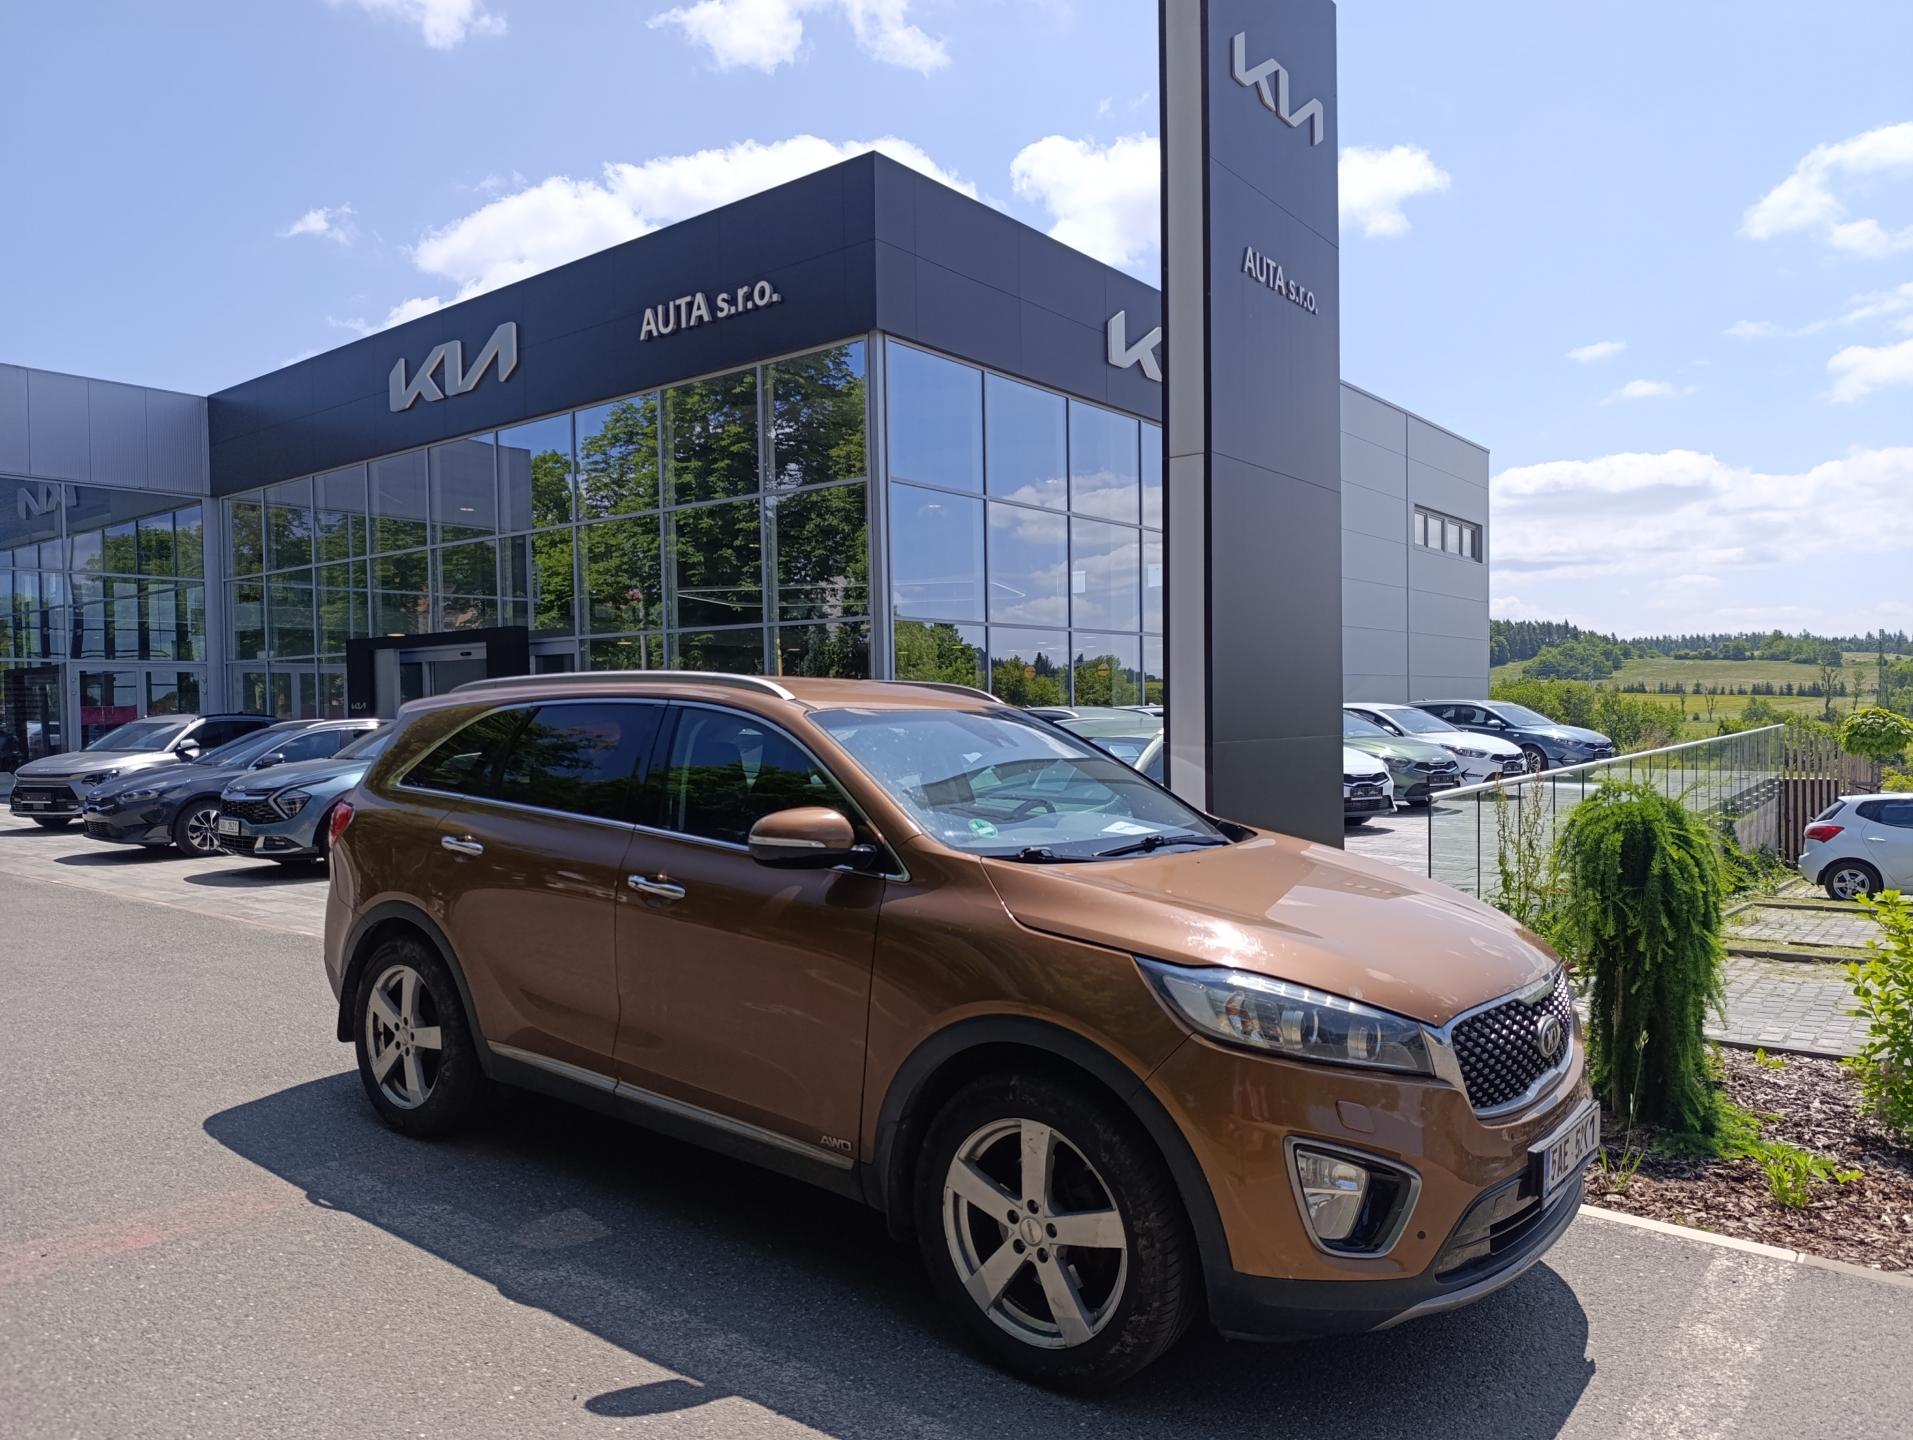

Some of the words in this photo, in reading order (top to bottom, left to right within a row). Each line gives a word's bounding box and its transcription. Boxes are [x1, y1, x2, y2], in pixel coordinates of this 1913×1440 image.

[1231, 31, 1324, 146] KIA
[640, 291, 713, 341] AUTA
[716, 280, 782, 318] s.r.o.
[1242, 246, 1286, 295] AUTA
[1287, 280, 1319, 315] s.r.o.
[389, 321, 518, 412] KIA
[1107, 310, 1163, 383] K
[820, 1135, 852, 1151] AWD
